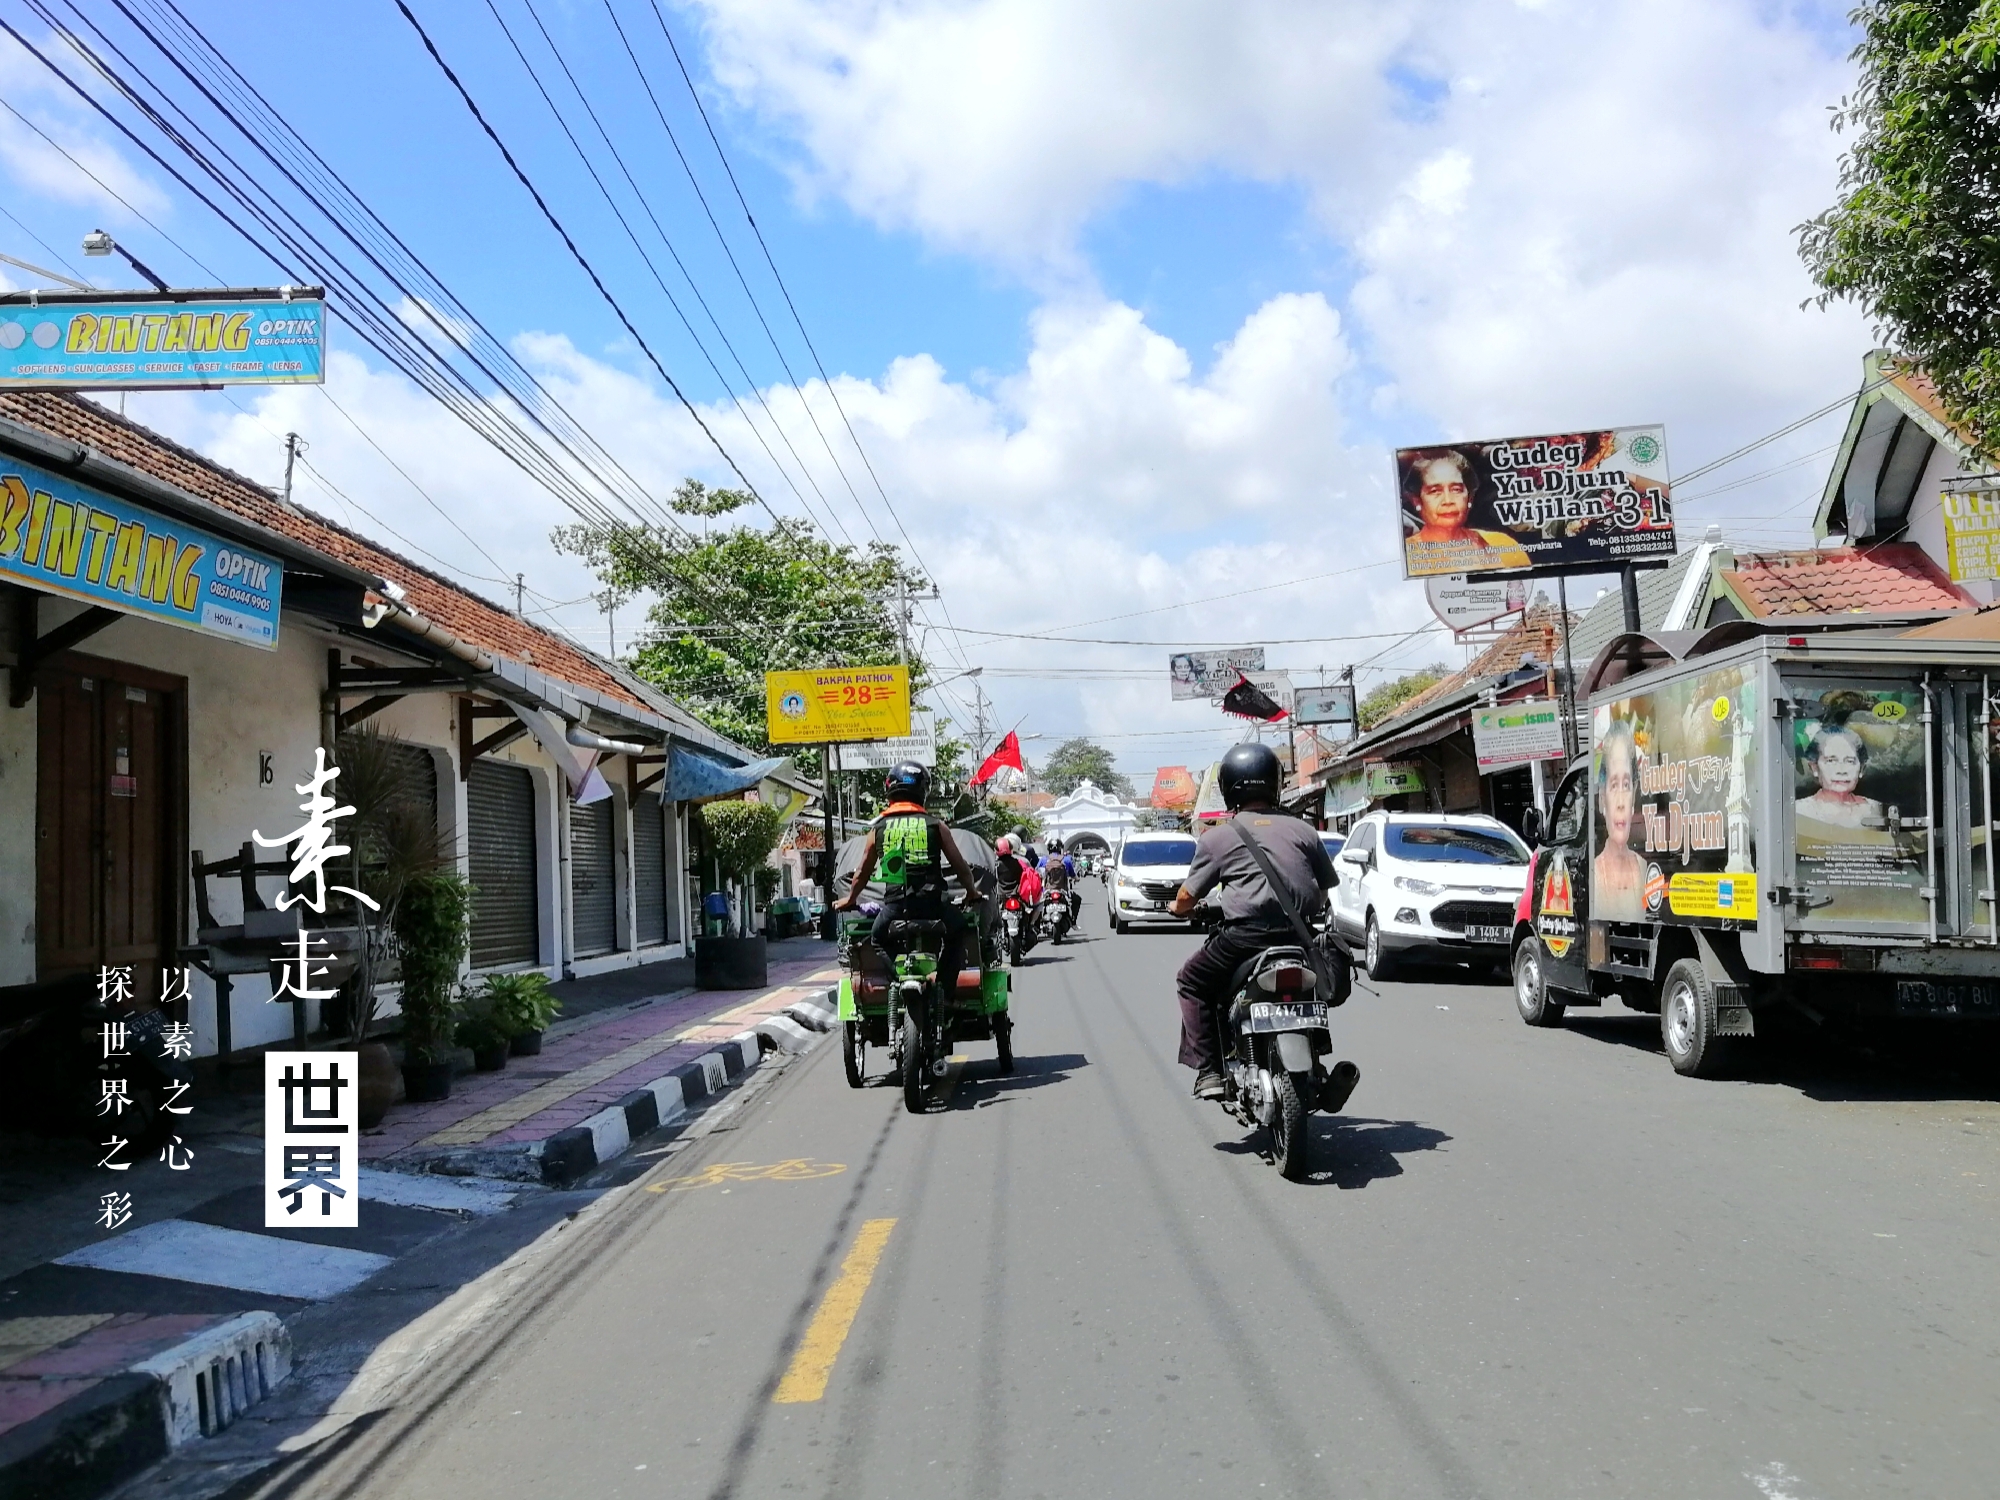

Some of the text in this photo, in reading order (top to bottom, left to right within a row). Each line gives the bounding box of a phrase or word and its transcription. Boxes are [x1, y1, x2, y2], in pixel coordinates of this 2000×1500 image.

[65, 312, 253, 354] BINTANG
[258, 319, 318, 336] OPTIK
[254, 337, 319, 347] 0851 0444 9905
[95, 363, 135, 373] GLASSES
[145, 363, 183, 373] SERVICE
[194, 363, 220, 372] FASET
[231, 363, 263, 372] FRAME
[273, 362, 302, 371] LENSA
[1490, 442, 1582, 470] Gudeg
[1491, 467, 1629, 498] Yu Djum
[1493, 487, 1671, 530] Wijilan 31
[0, 474, 206, 612] BINTANG
[1517, 541, 1563, 553] Yogyakarta
[1588, 537, 1609, 548] Telp.
[1955, 534, 1989, 547] BAKPIA
[1956, 546, 1987, 558] KRIPIK
[215, 548, 271, 592] OPTIK
[1958, 566, 1996, 580] YANGKO
[210, 580, 272, 612] 0851 0444 9905
[214, 612, 232, 628] HOYA
[817, 674, 895, 686] BAKPIA PATHOK
[843, 685, 872, 706] 28
[260, 754, 274, 786] 16
[1640, 752, 1687, 803] Gudeg
[1643, 800, 1726, 866] Yu Djum
[1254, 1004, 1327, 1018] AB 4147 HF
